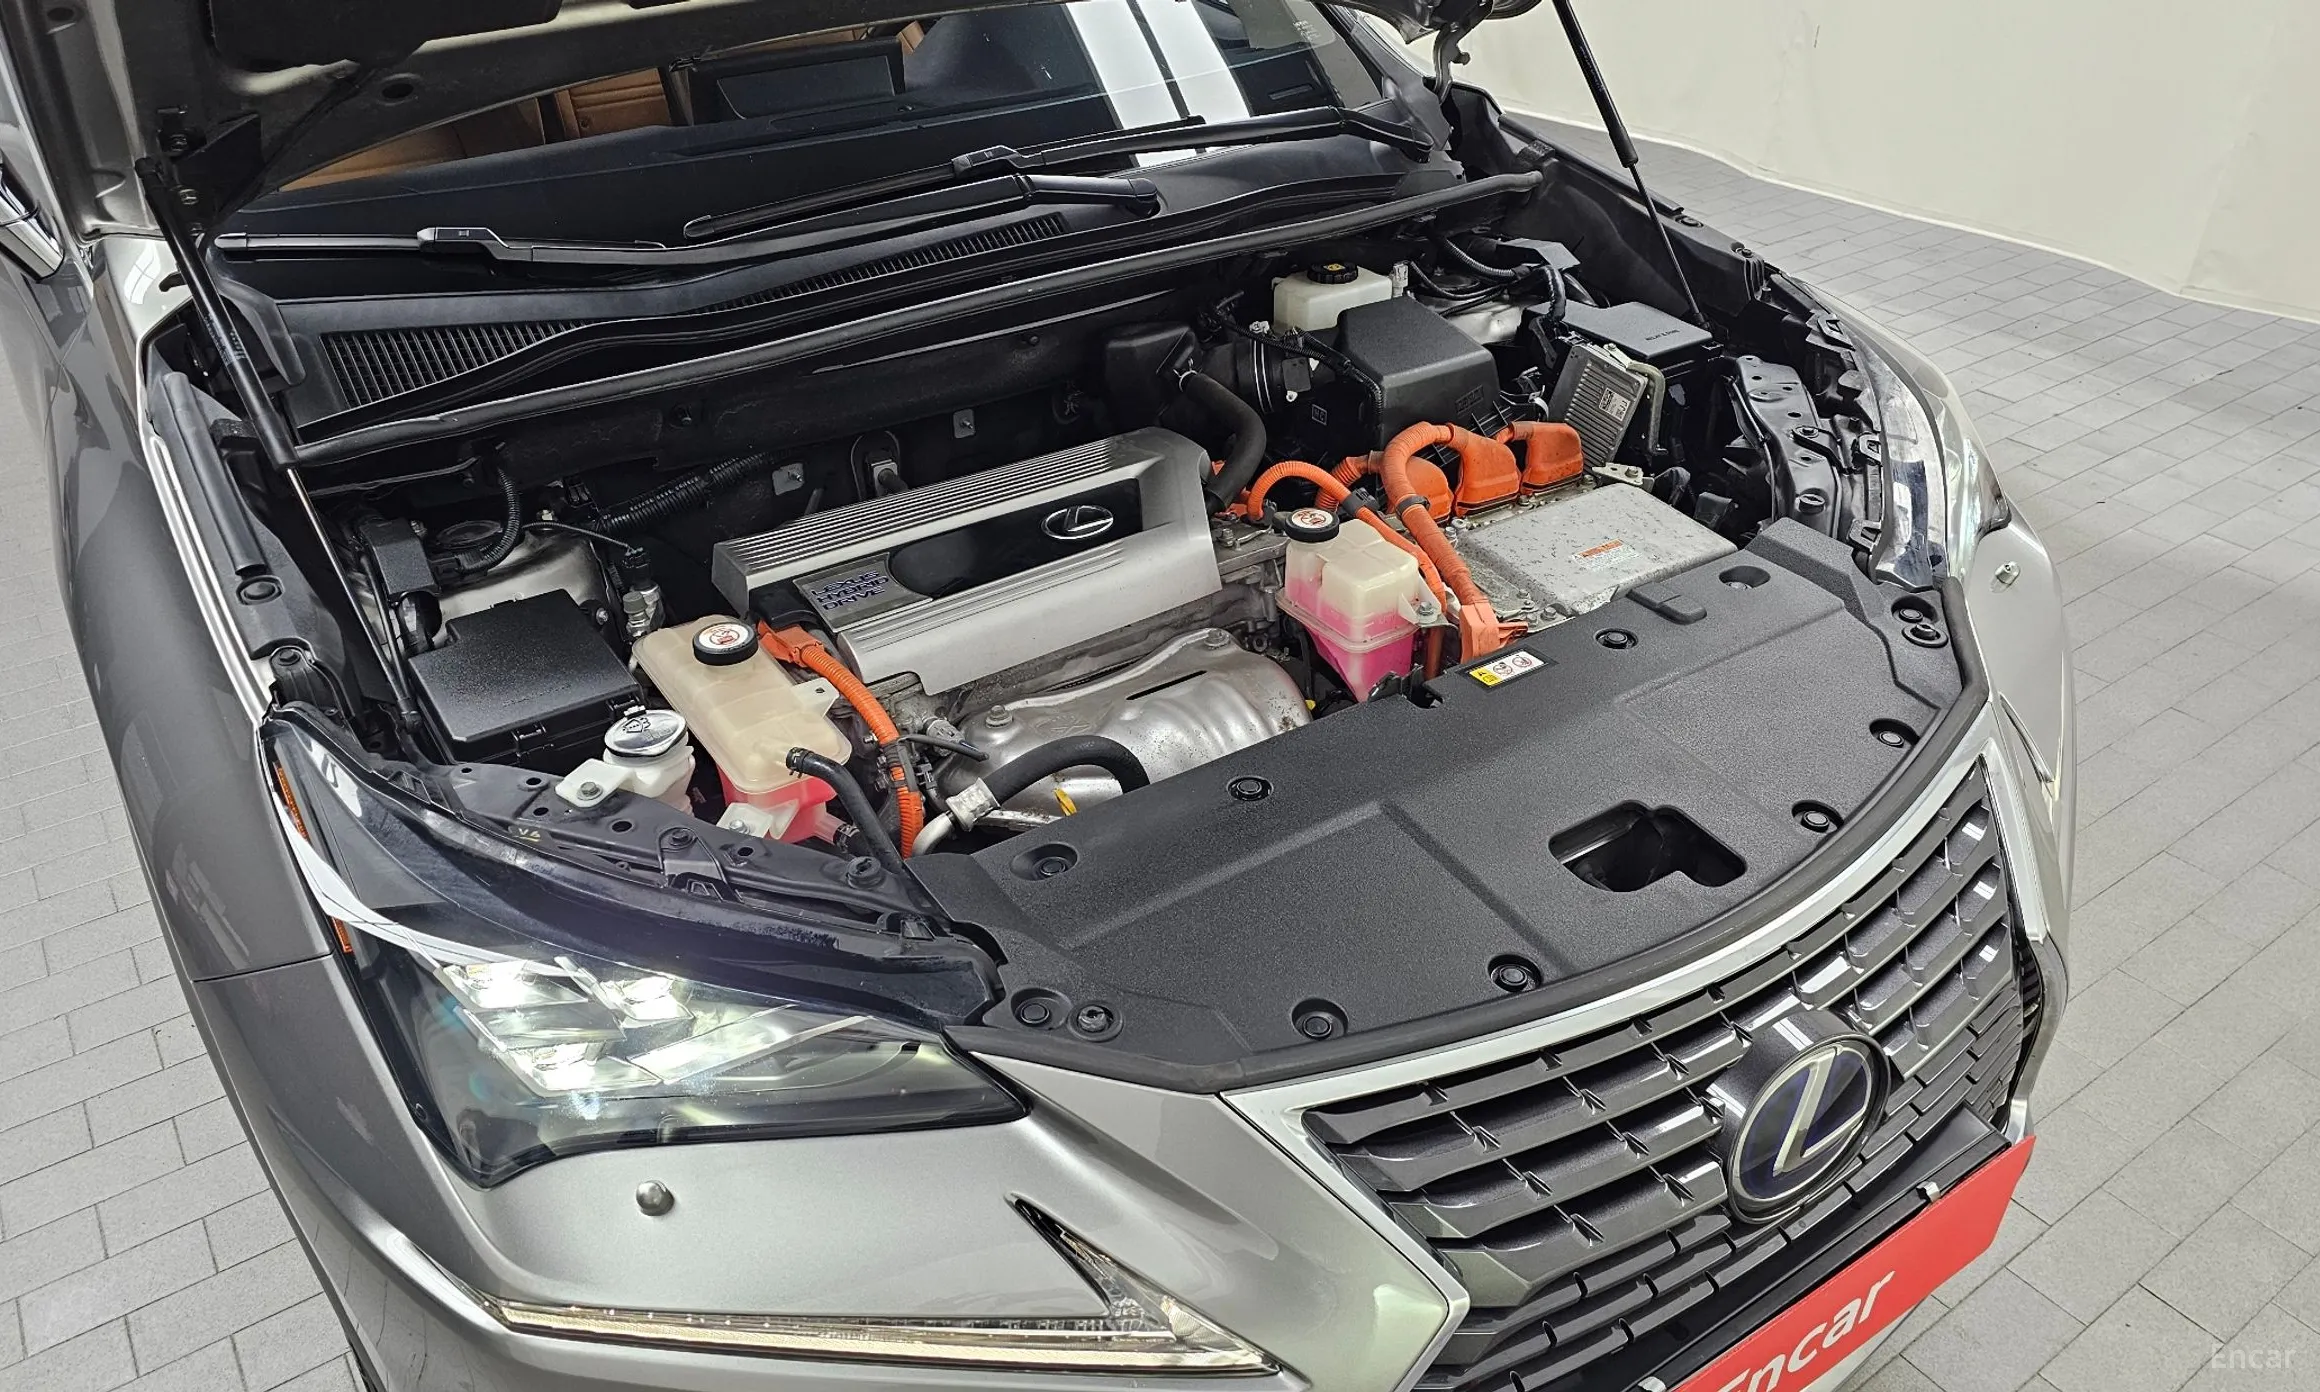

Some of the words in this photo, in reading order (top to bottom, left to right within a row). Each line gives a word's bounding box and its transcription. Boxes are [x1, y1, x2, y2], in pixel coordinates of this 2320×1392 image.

[811, 569, 880, 596] LEXUS
[817, 575, 889, 603] HYBRID
[822, 586, 886, 610] DRIVE
